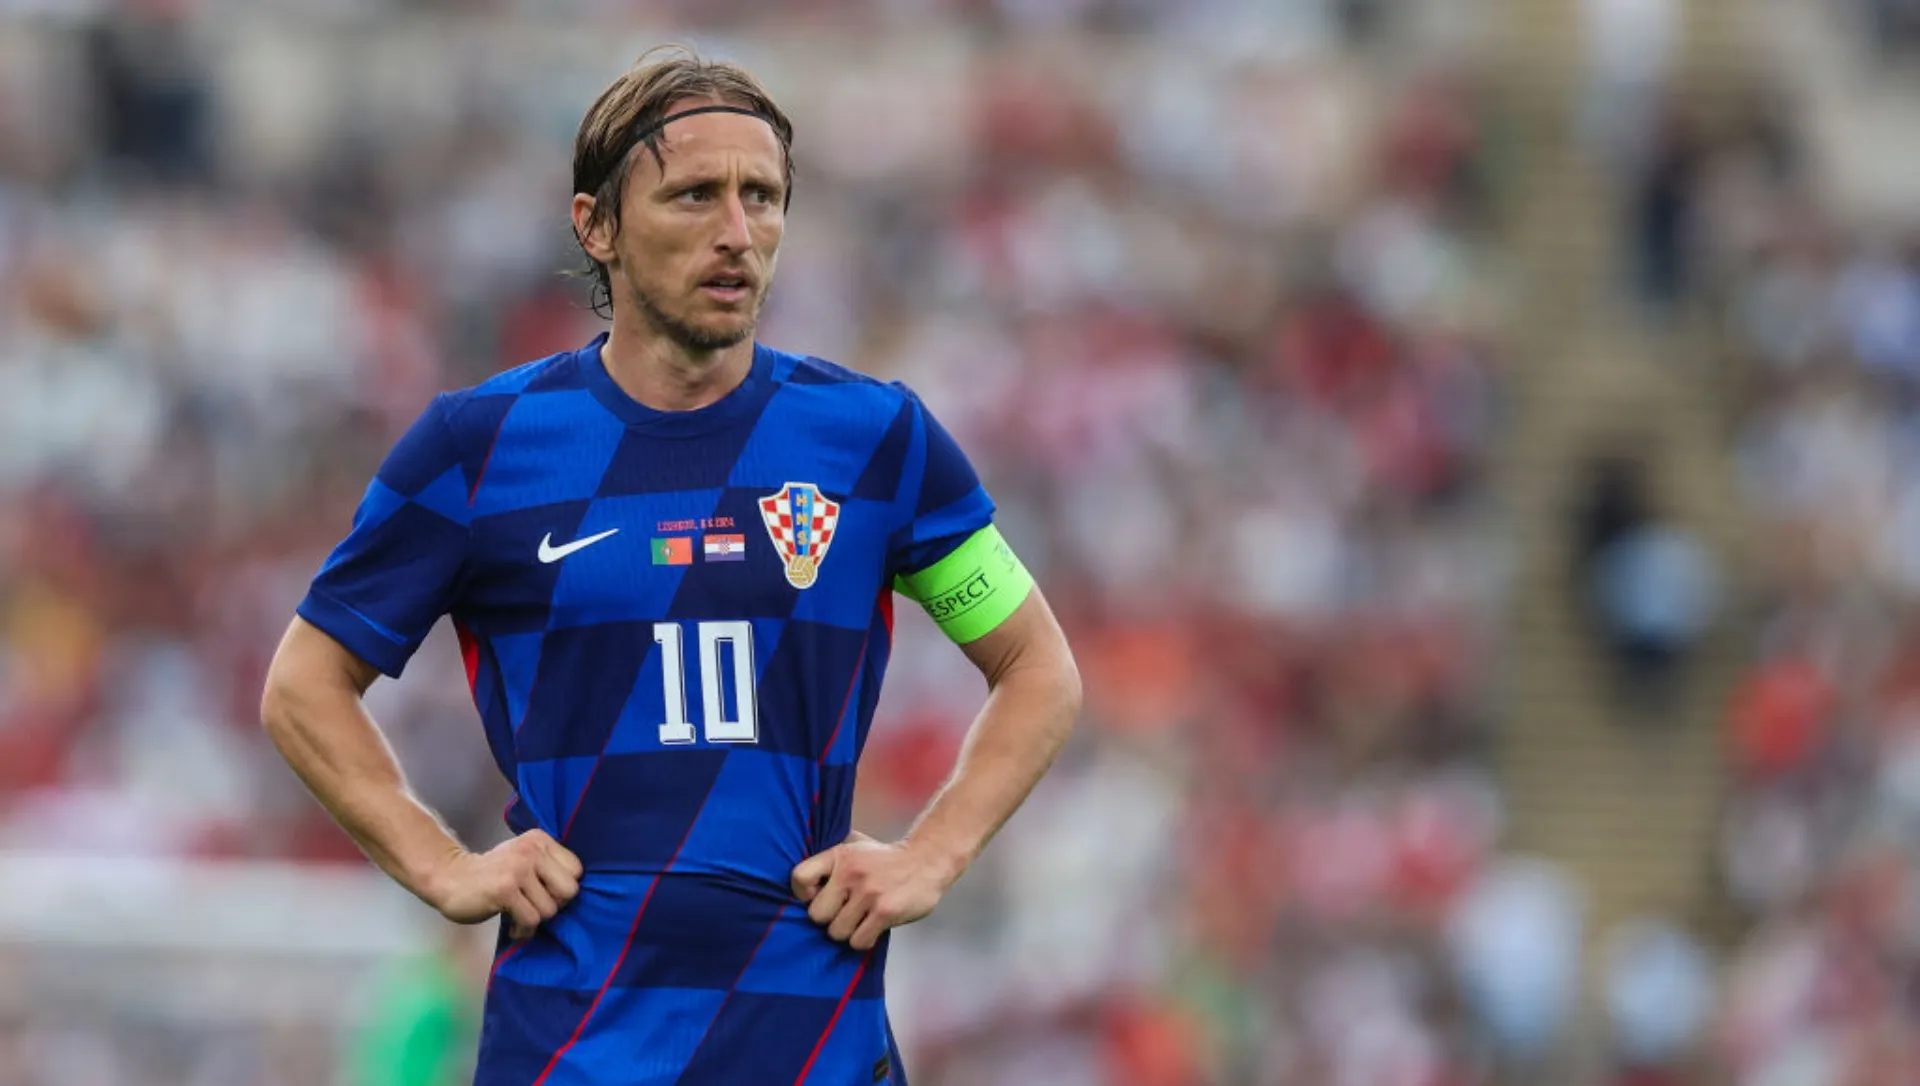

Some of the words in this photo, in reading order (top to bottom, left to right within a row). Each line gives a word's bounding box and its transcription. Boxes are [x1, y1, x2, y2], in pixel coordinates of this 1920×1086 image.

[796, 493, 808, 545] HNS
[927, 573, 989, 618] ESPECT
[653, 621, 759, 745] 10
